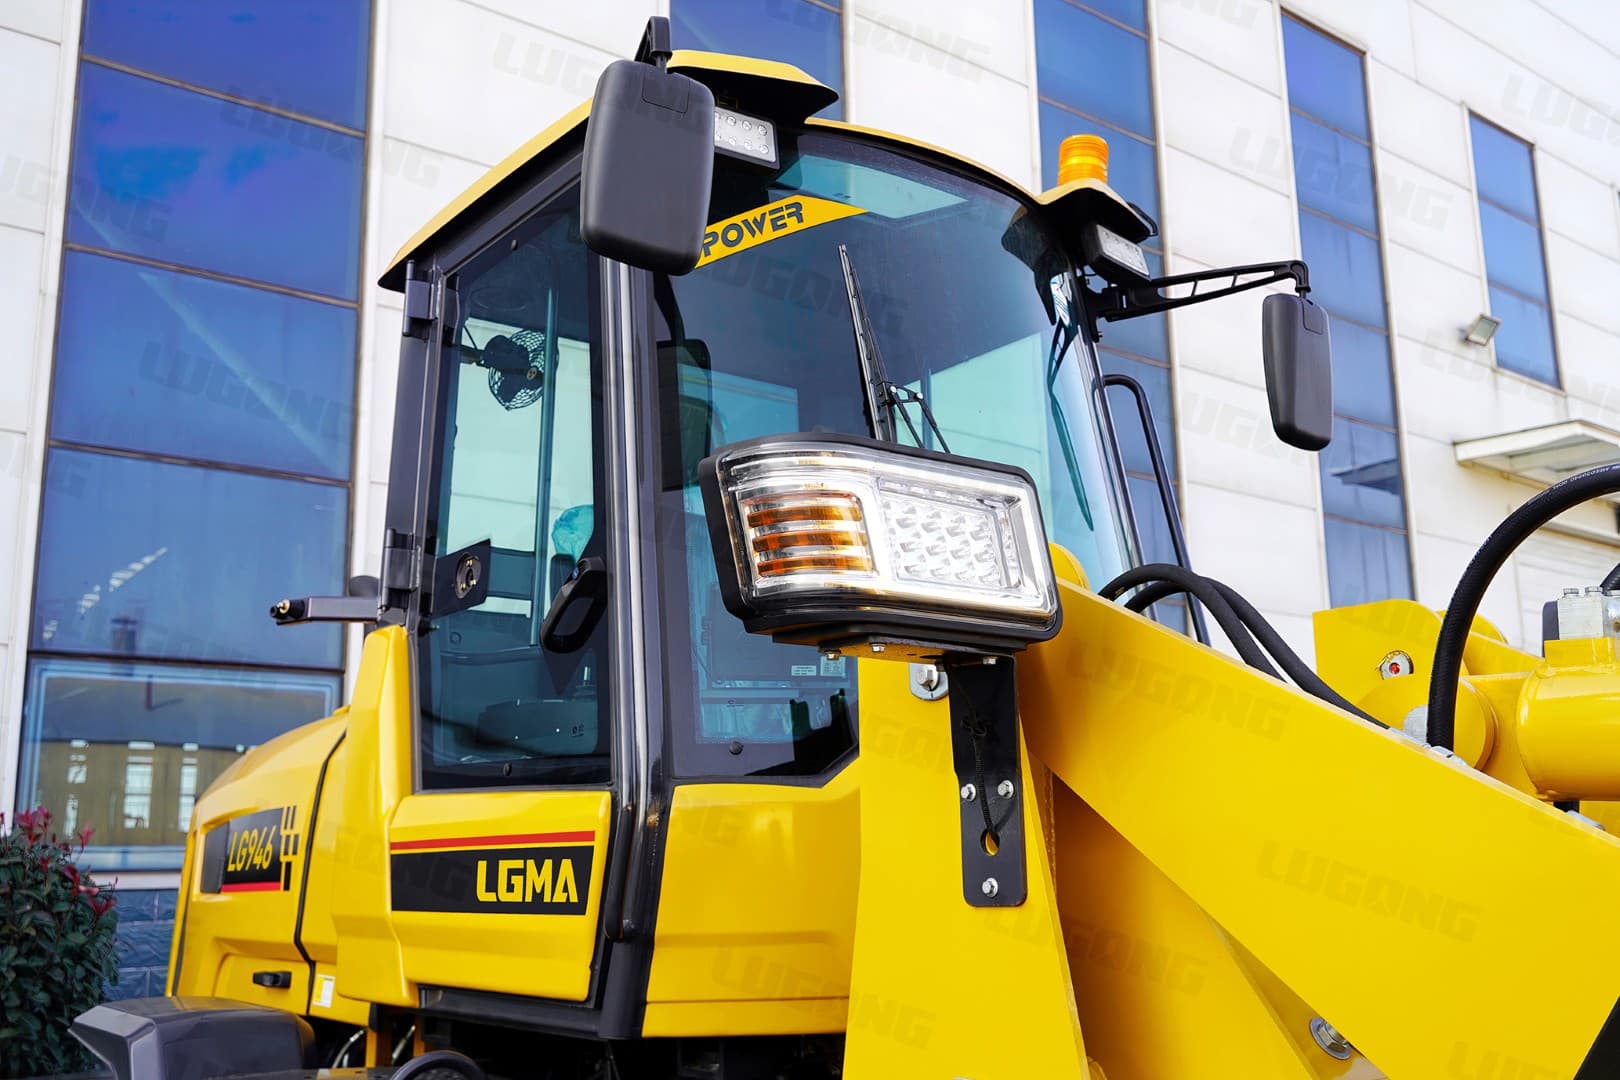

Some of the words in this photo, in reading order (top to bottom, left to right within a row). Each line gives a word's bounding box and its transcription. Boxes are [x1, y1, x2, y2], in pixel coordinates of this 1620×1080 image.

[702, 201, 804, 257] POWER
[226, 825, 276, 872] LG946
[476, 858, 579, 903] LGMA
